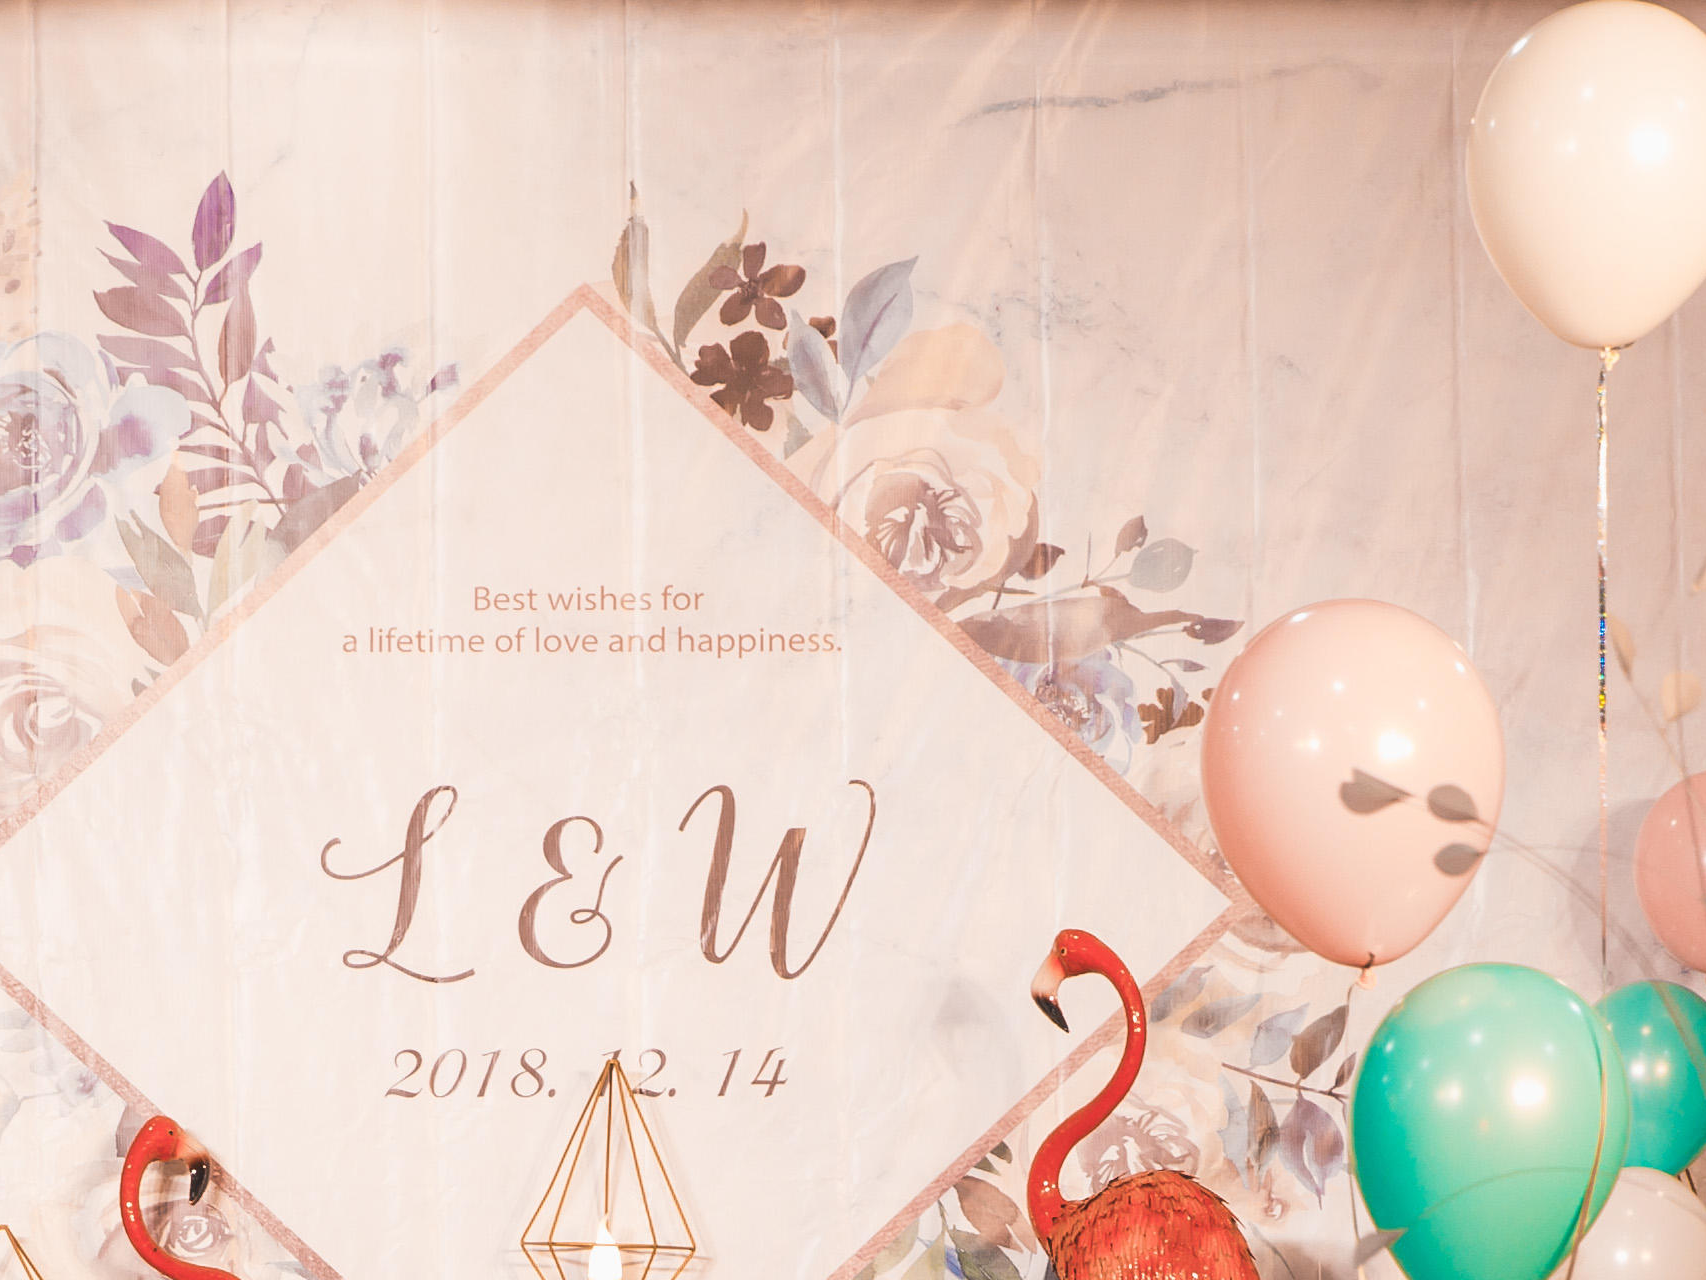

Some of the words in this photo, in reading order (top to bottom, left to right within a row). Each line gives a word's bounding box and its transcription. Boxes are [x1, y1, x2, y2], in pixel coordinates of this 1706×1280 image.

[474, 585, 537, 611] Best
[547, 585, 652, 611] wishes
[660, 584, 704, 611] for
[342, 634, 357, 654] a
[369, 627, 485, 654] lifetime
[495, 627, 526, 654] of
[534, 626, 598, 654] love
[609, 626, 665, 654] and
[677, 626, 842, 659] happiness.
[321, 785, 475, 984] L
[518, 816, 623, 969] &
[678, 779, 876, 980] W
[385, 1048, 556, 1098] 2018.
[717, 1046, 789, 1098] 14
